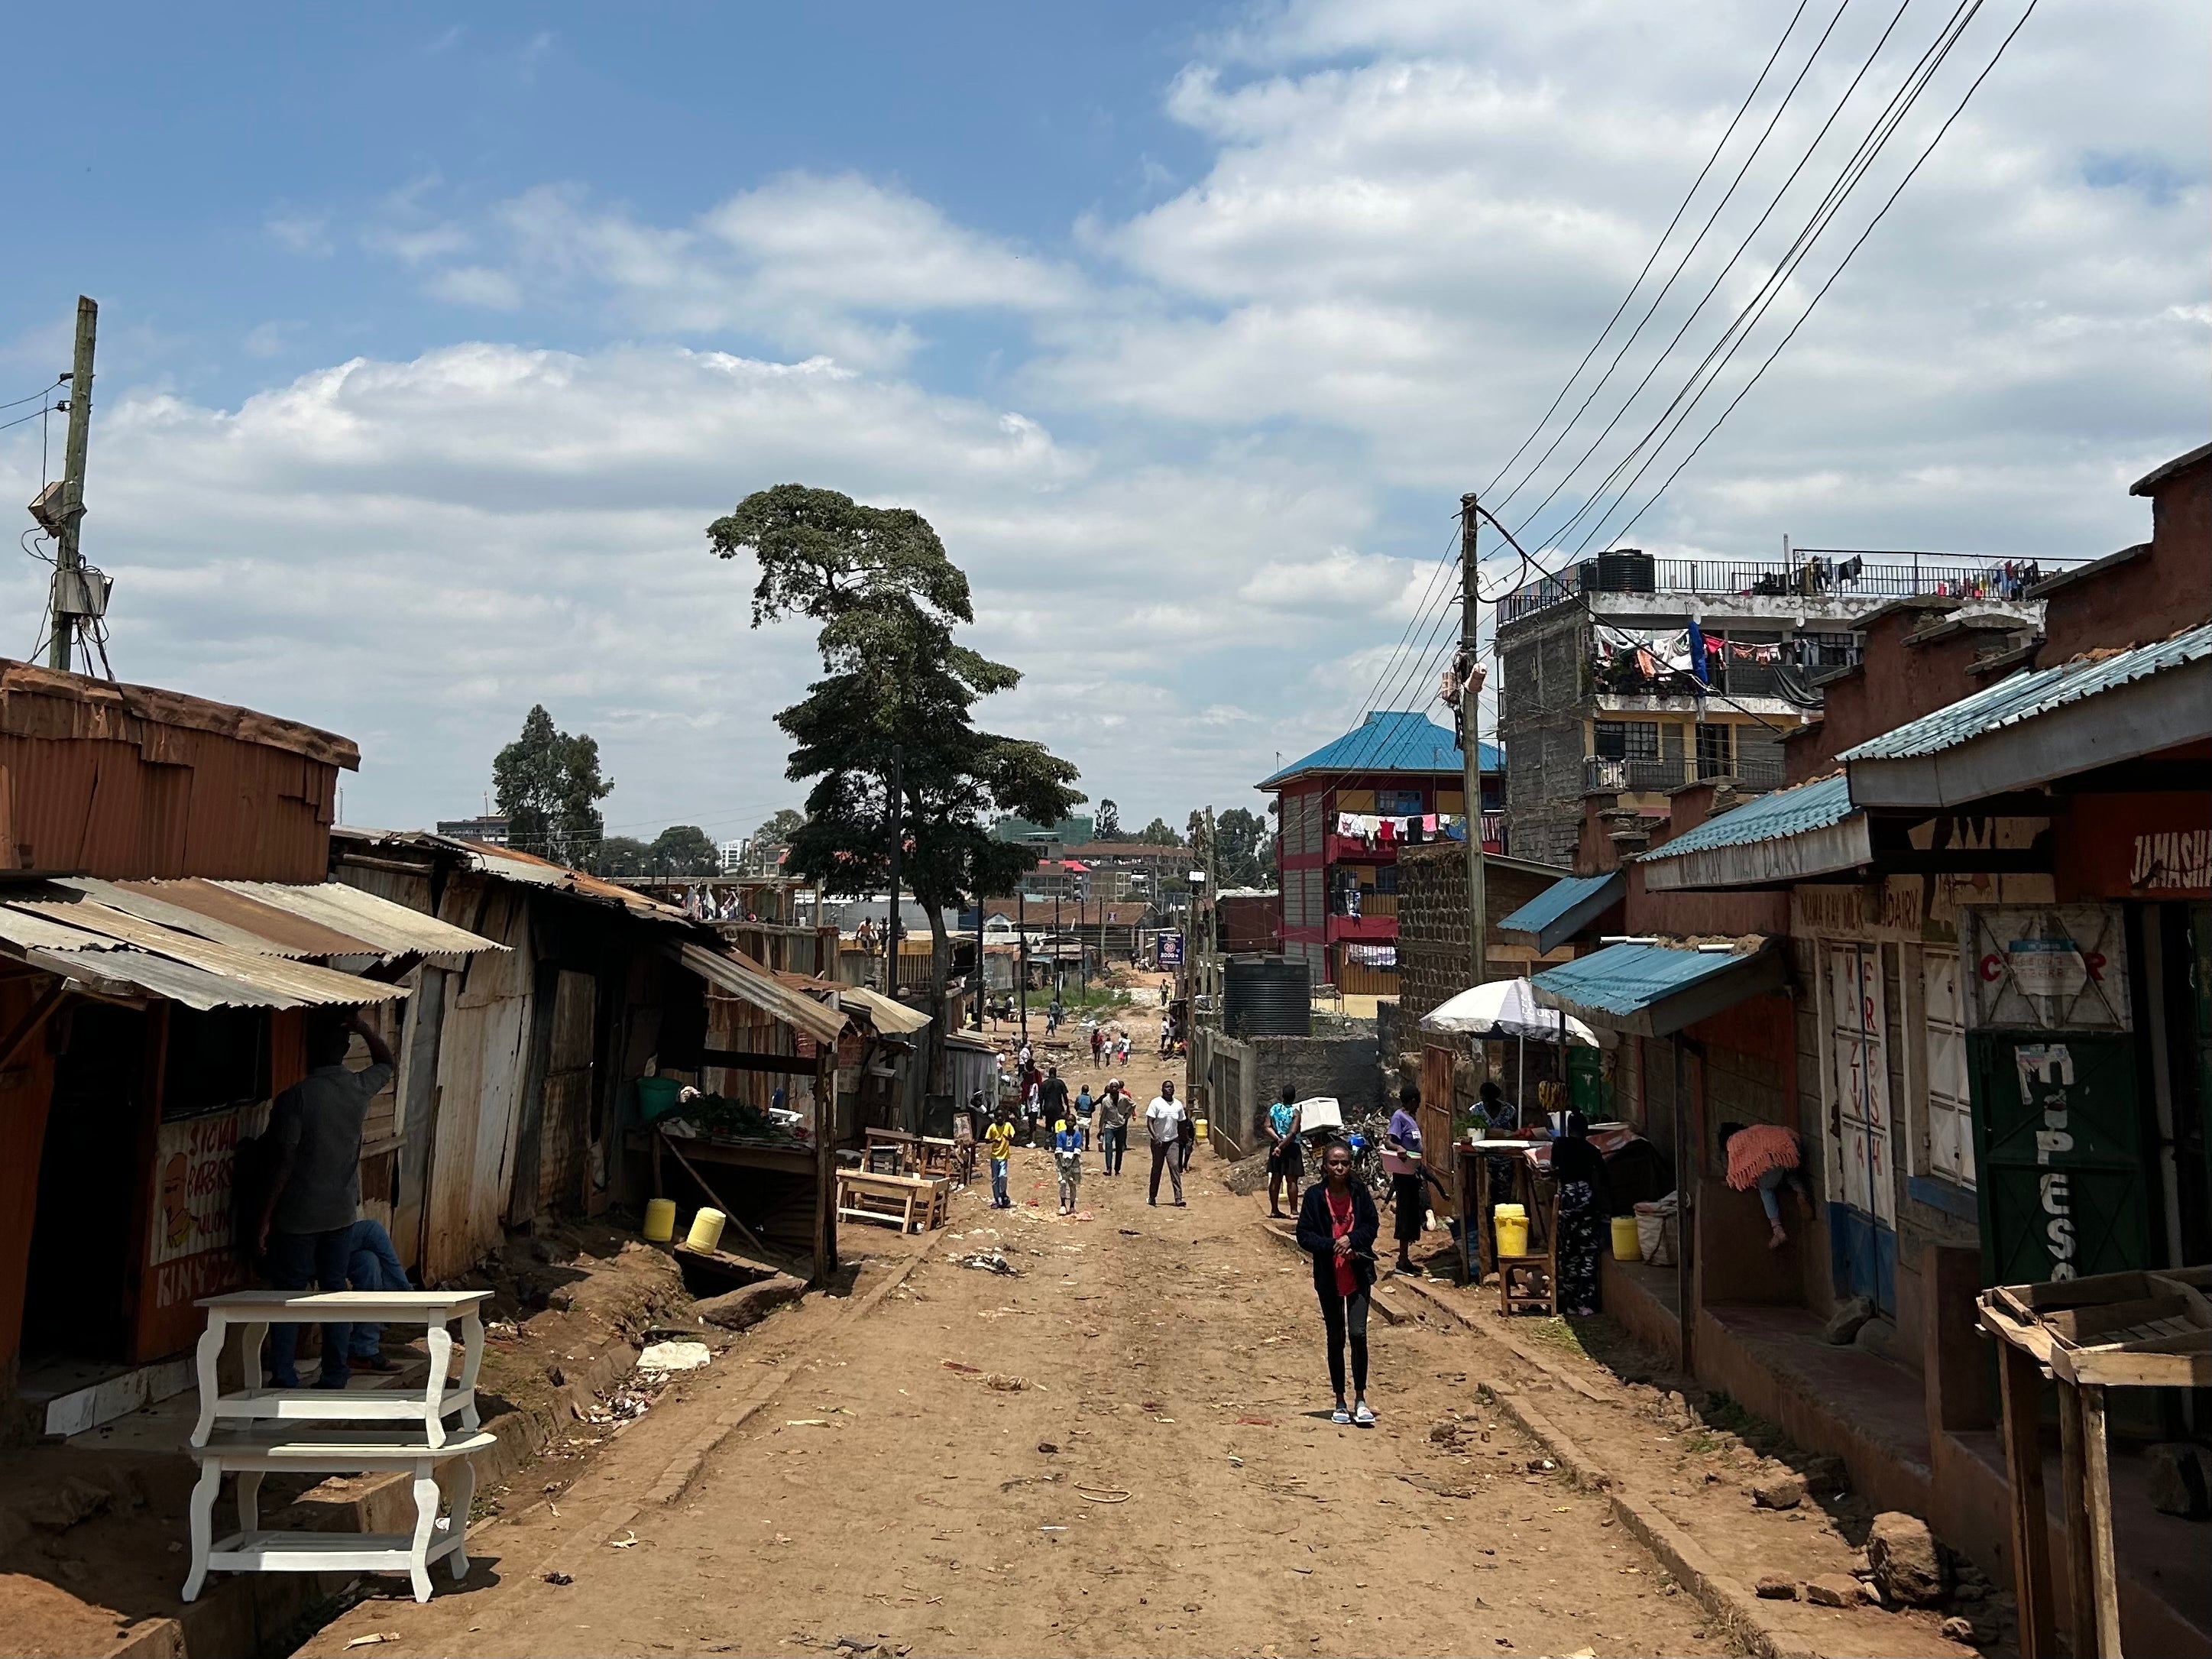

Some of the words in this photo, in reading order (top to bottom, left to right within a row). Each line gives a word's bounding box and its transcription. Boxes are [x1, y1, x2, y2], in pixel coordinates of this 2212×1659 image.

[1763, 838, 1805, 877] DAIRY
[2130, 830, 2212, 889] JAMASH
[1864, 961, 1882, 1176] FRESH
